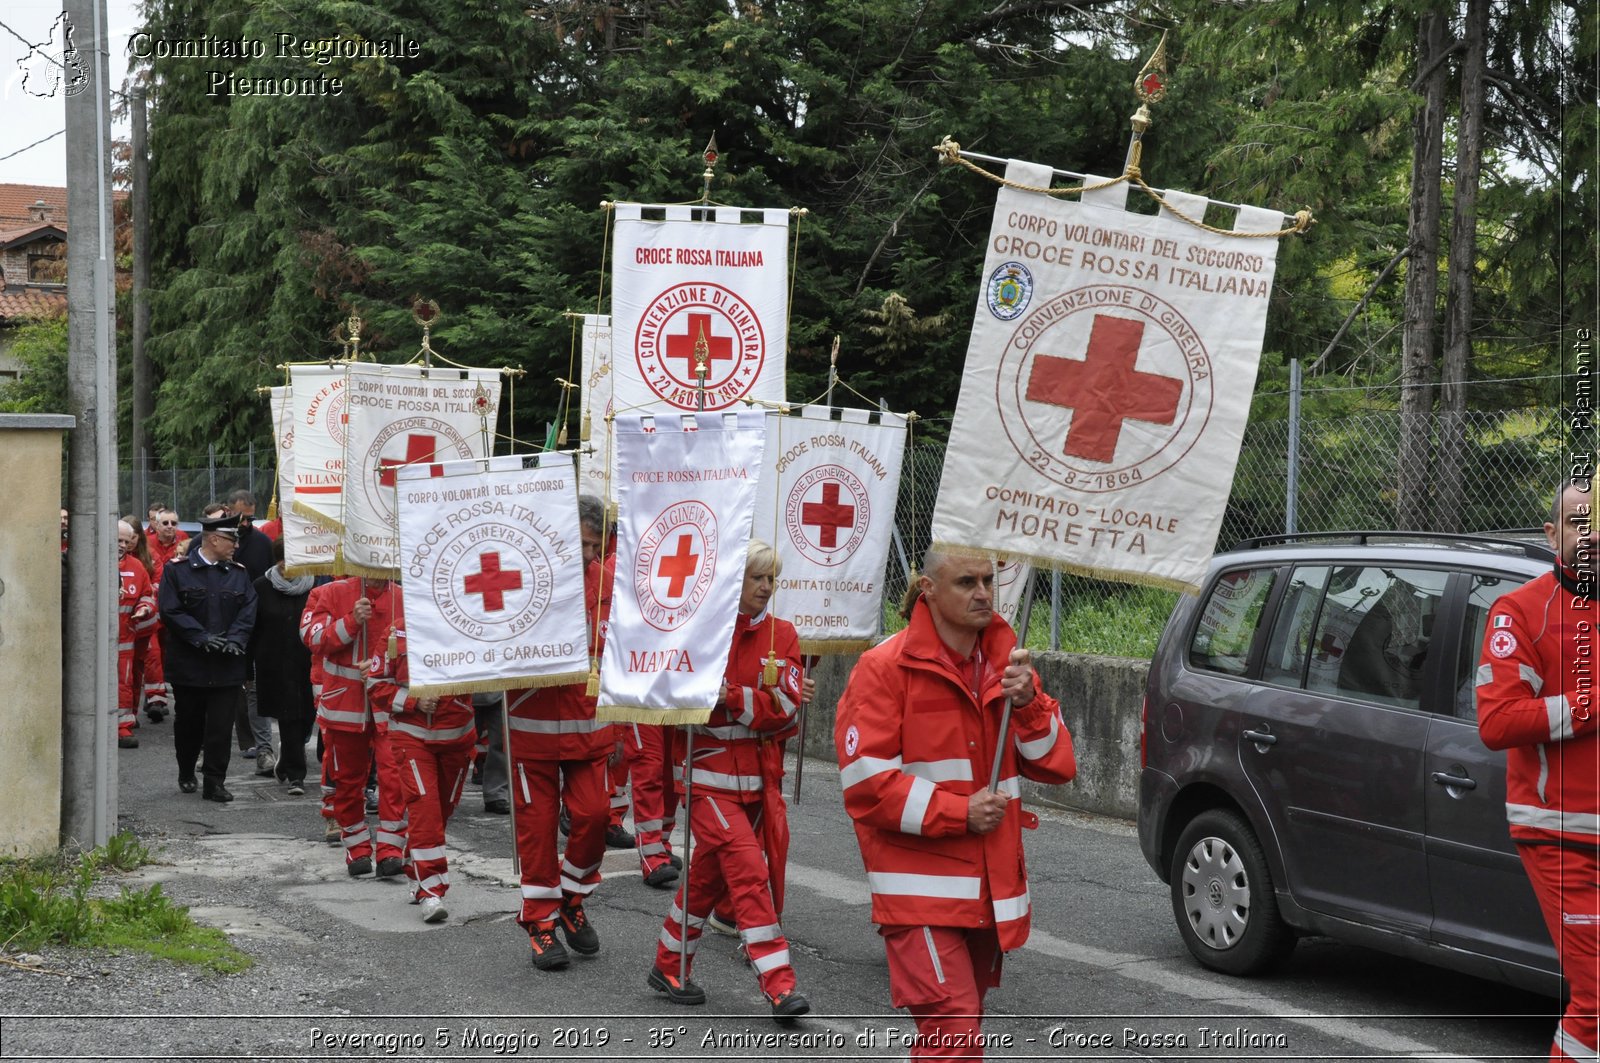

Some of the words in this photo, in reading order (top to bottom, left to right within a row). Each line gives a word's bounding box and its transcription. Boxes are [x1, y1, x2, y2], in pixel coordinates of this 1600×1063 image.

[1008, 211, 1057, 238] CORPO
[1064, 223, 1145, 252] VOLONTARI
[1152, 238, 1180, 262] DEL
[1185, 245, 1263, 274] SOCCORSO
[636, 248, 672, 264] CROCE
[676, 249, 712, 266] ROSSA
[716, 250, 763, 267] ITALIANA
[993, 234, 1073, 266] CROCE
[1081, 252, 1159, 281] ROSSA
[1169, 267, 1268, 299] ITALIANA
[641, 288, 707, 359] CONVENZIONE
[712, 290, 726, 307] DI
[728, 302, 759, 361] GINEVRA
[1014, 288, 1133, 351] CONVENZIONE
[1140, 295, 1158, 313] DI
[1160, 310, 1209, 382] GINEVRA
[358, 381, 384, 393] CORPO
[386, 384, 428, 398] VOLONTARI
[433, 388, 449, 399] DEL
[652, 375, 671, 394] 22
[670, 389, 716, 407] AGOSTO
[718, 378, 745, 400] 1864
[307, 387, 331, 425] CROCE
[351, 395, 393, 410] CROCE
[398, 400, 440, 412] ROSSA
[369, 419, 427, 458] CONVENZIONE
[432, 421, 443, 430] DI
[444, 427, 471, 459] GINEVR
[776, 441, 809, 474] CROCE
[811, 435, 845, 448] ROSSA
[849, 440, 887, 481] ITALIANA
[298, 474, 347, 485] VILLANO
[632, 471, 664, 483] CROCE
[668, 470, 701, 483] ROSSA
[704, 468, 747, 481] ITALIANA
[805, 475, 814, 485] DI
[815, 468, 850, 482] GINEVRA
[849, 480, 861, 492] 22
[408, 491, 438, 504] CORPO
[442, 485, 489, 502] VOLONTARI
[495, 485, 513, 496] DEL
[517, 479, 564, 495] SOCCORSO
[788, 481, 807, 550] CONVENZIONE
[857, 492, 868, 534] AGOSTO
[986, 486, 1079, 517] COMITATO
[1100, 508, 1179, 534] LOCALE
[409, 522, 448, 578] CROCE
[446, 500, 504, 528] ROSSA
[510, 504, 573, 566] ITALIANA
[468, 526, 524, 547] GINEVRA
[847, 536, 860, 553] 1864
[996, 509, 1145, 555] MORETTA
[451, 540, 466, 555] DI
[525, 546, 542, 562] 22
[637, 533, 666, 624] CONVENZIONE
[656, 517, 669, 536] DI
[669, 506, 710, 531] GINEVRA
[692, 548, 715, 603] AGOSTO
[436, 558, 484, 637] CONVENZIONE
[532, 564, 549, 610] AGOSTO
[774, 579, 831, 592] COMITATO
[835, 580, 874, 593] LOCALE
[823, 598, 831, 608] DI
[509, 609, 537, 634] 1864
[795, 614, 849, 628] DRONERO
[423, 651, 476, 668] GRUPPO
[483, 651, 496, 663] di
[503, 642, 574, 661] CARAGLIO
[628, 649, 695, 673] MANTA
